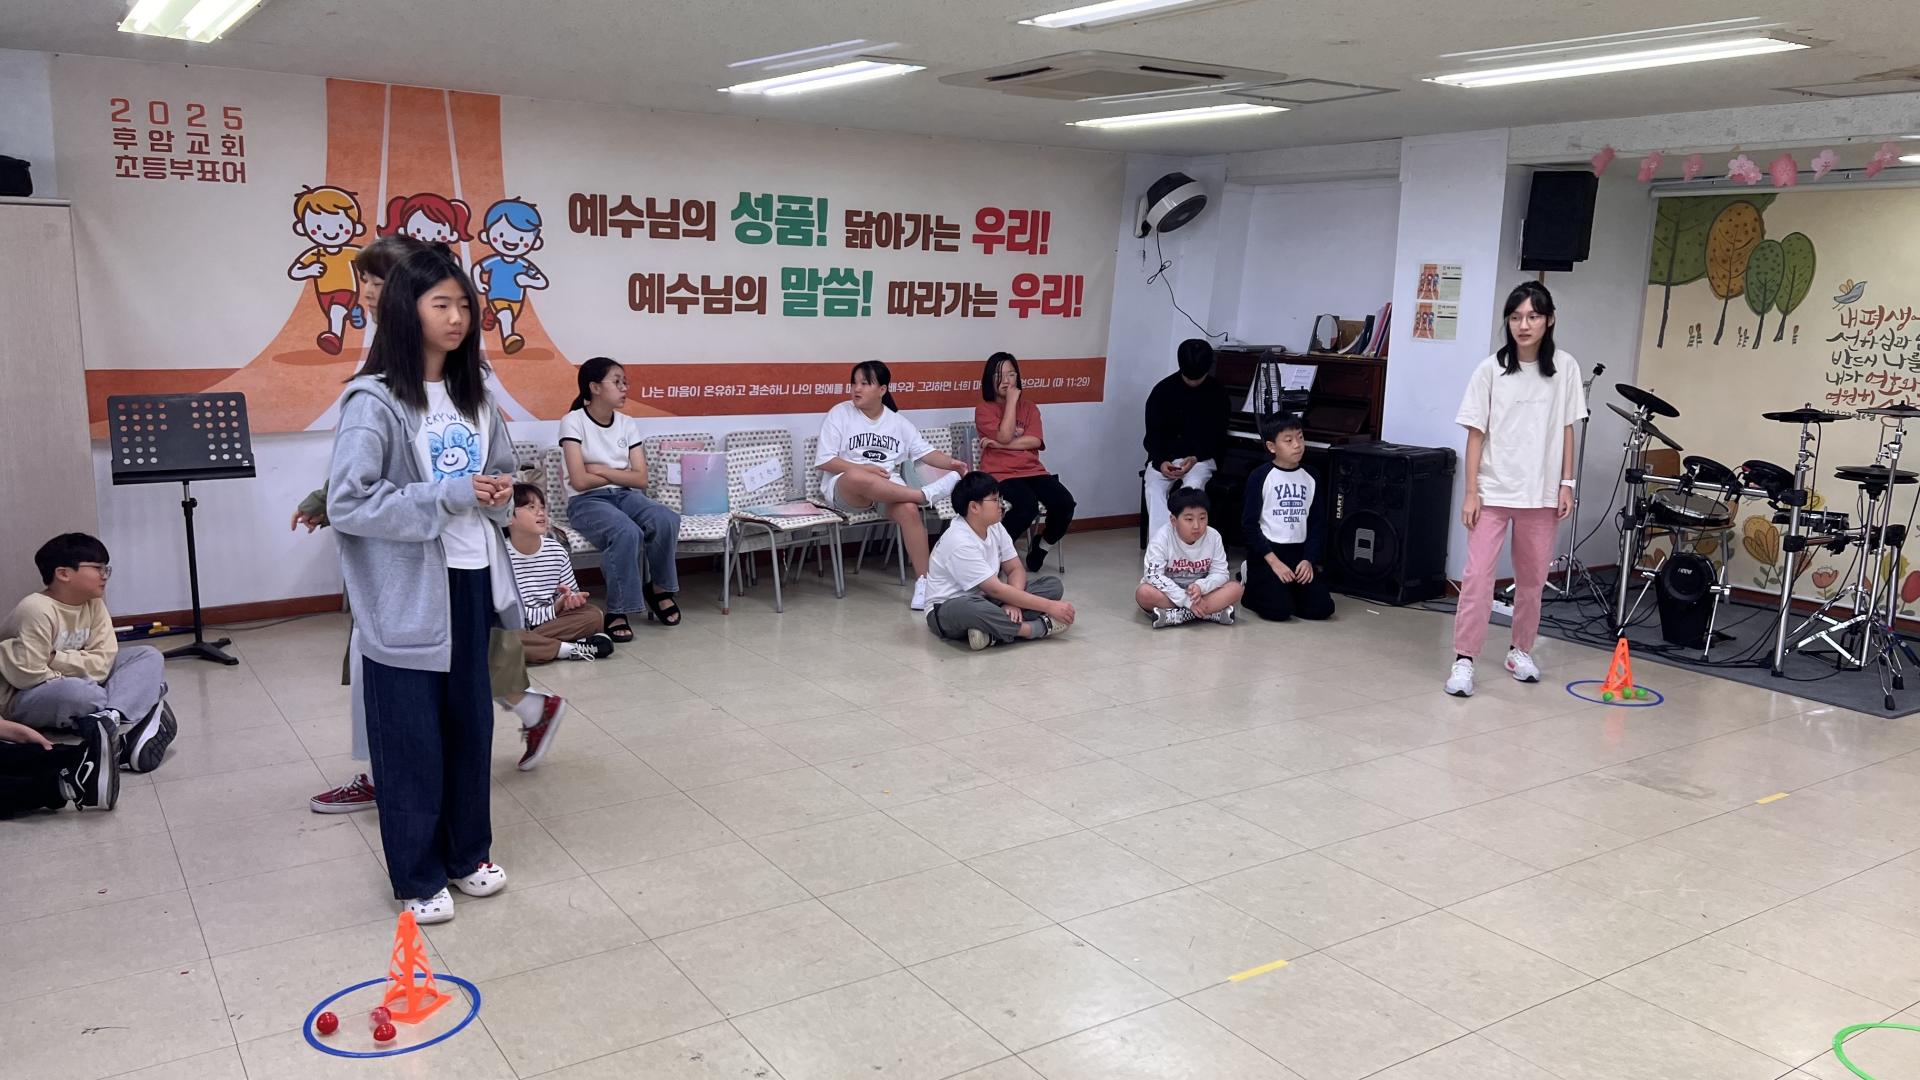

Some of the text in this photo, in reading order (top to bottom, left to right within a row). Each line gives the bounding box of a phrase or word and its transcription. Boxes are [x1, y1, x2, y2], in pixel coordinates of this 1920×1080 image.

[110, 97, 243, 131] 2025
[114, 154, 246, 184] 초등부표어
[568, 191, 1051, 255] 예수님의 성품! 닮아가는 우리!
[628, 266, 1085, 319] 예수님의 말씀! 따라가는 우리!
[1840, 307, 1858, 328] 내
[1832, 348, 1878, 369] 반드시
[641, 385, 664, 399] 나는
[668, 384, 700, 398] 마음이
[703, 384, 746, 397] 온유하고
[749, 383, 790, 396] 겸손하니
[792, 382, 812, 396] 나의
[815, 382, 844, 396] 멍에를
[917, 380, 952, 393] 그리하면
[954, 379, 971, 391] 너희
[1066, 376, 1091, 388] 11:29)
[1825, 370, 1864, 386] 내가
[1825, 387, 1875, 406] 영원히
[849, 432, 900, 453] UNIVERSITY
[1274, 483, 1307, 500] YALE
[1272, 508, 1289, 516] NEW
